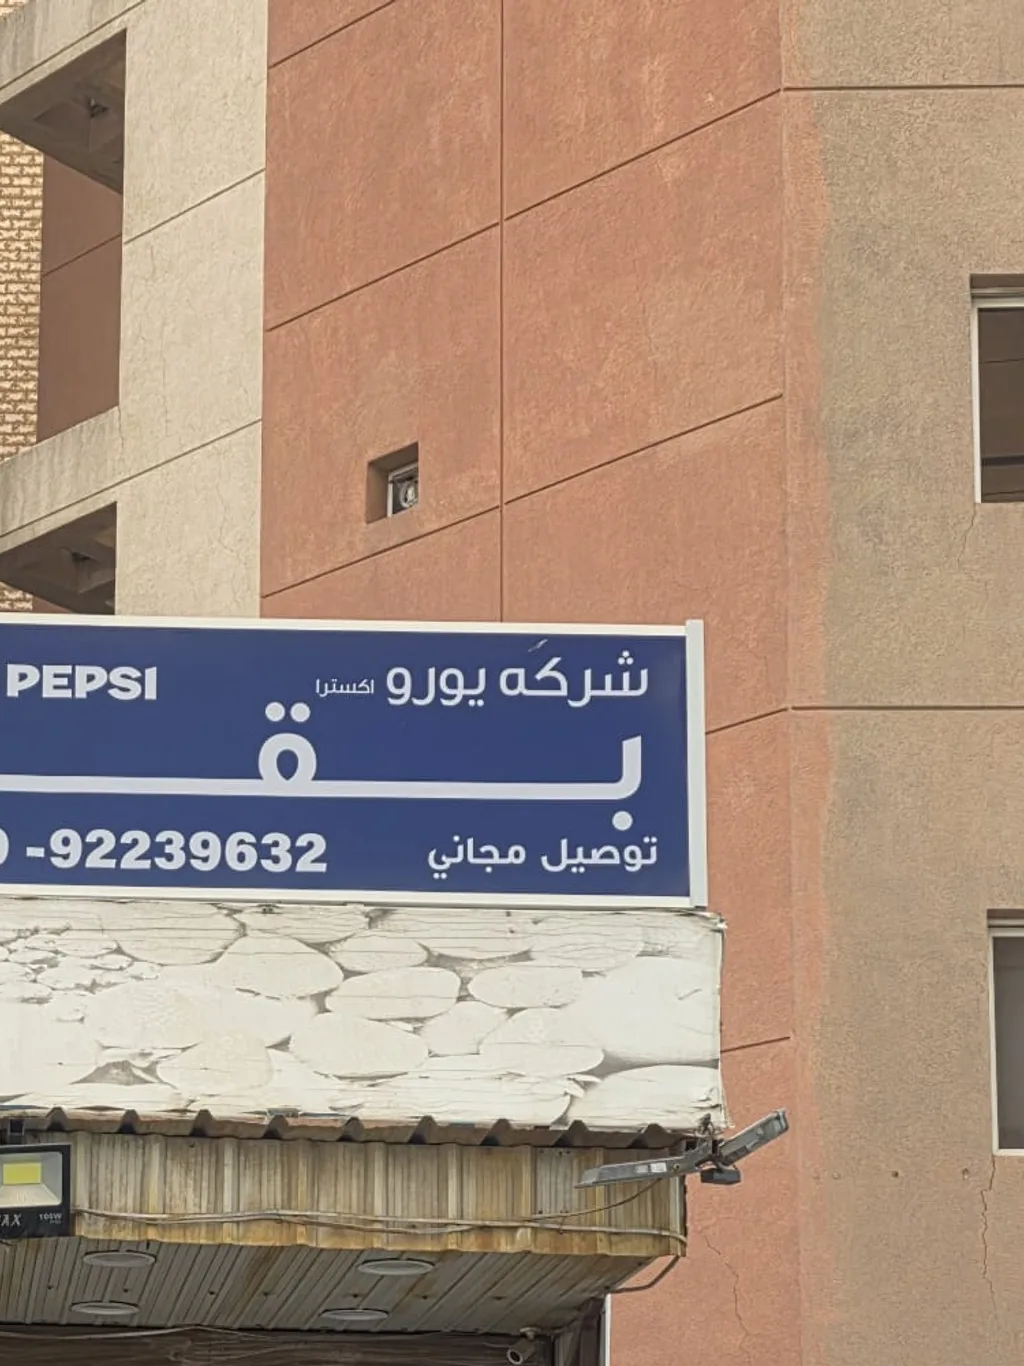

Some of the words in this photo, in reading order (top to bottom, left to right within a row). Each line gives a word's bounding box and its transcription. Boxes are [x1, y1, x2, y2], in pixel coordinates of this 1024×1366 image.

[6, 663, 158, 700] PEPSI
[315, 678, 375, 697] اكسترا
[386, 666, 487, 707] يورو
[427, 835, 527, 880] مجاني
[540, 836, 658, 873] توصيل
